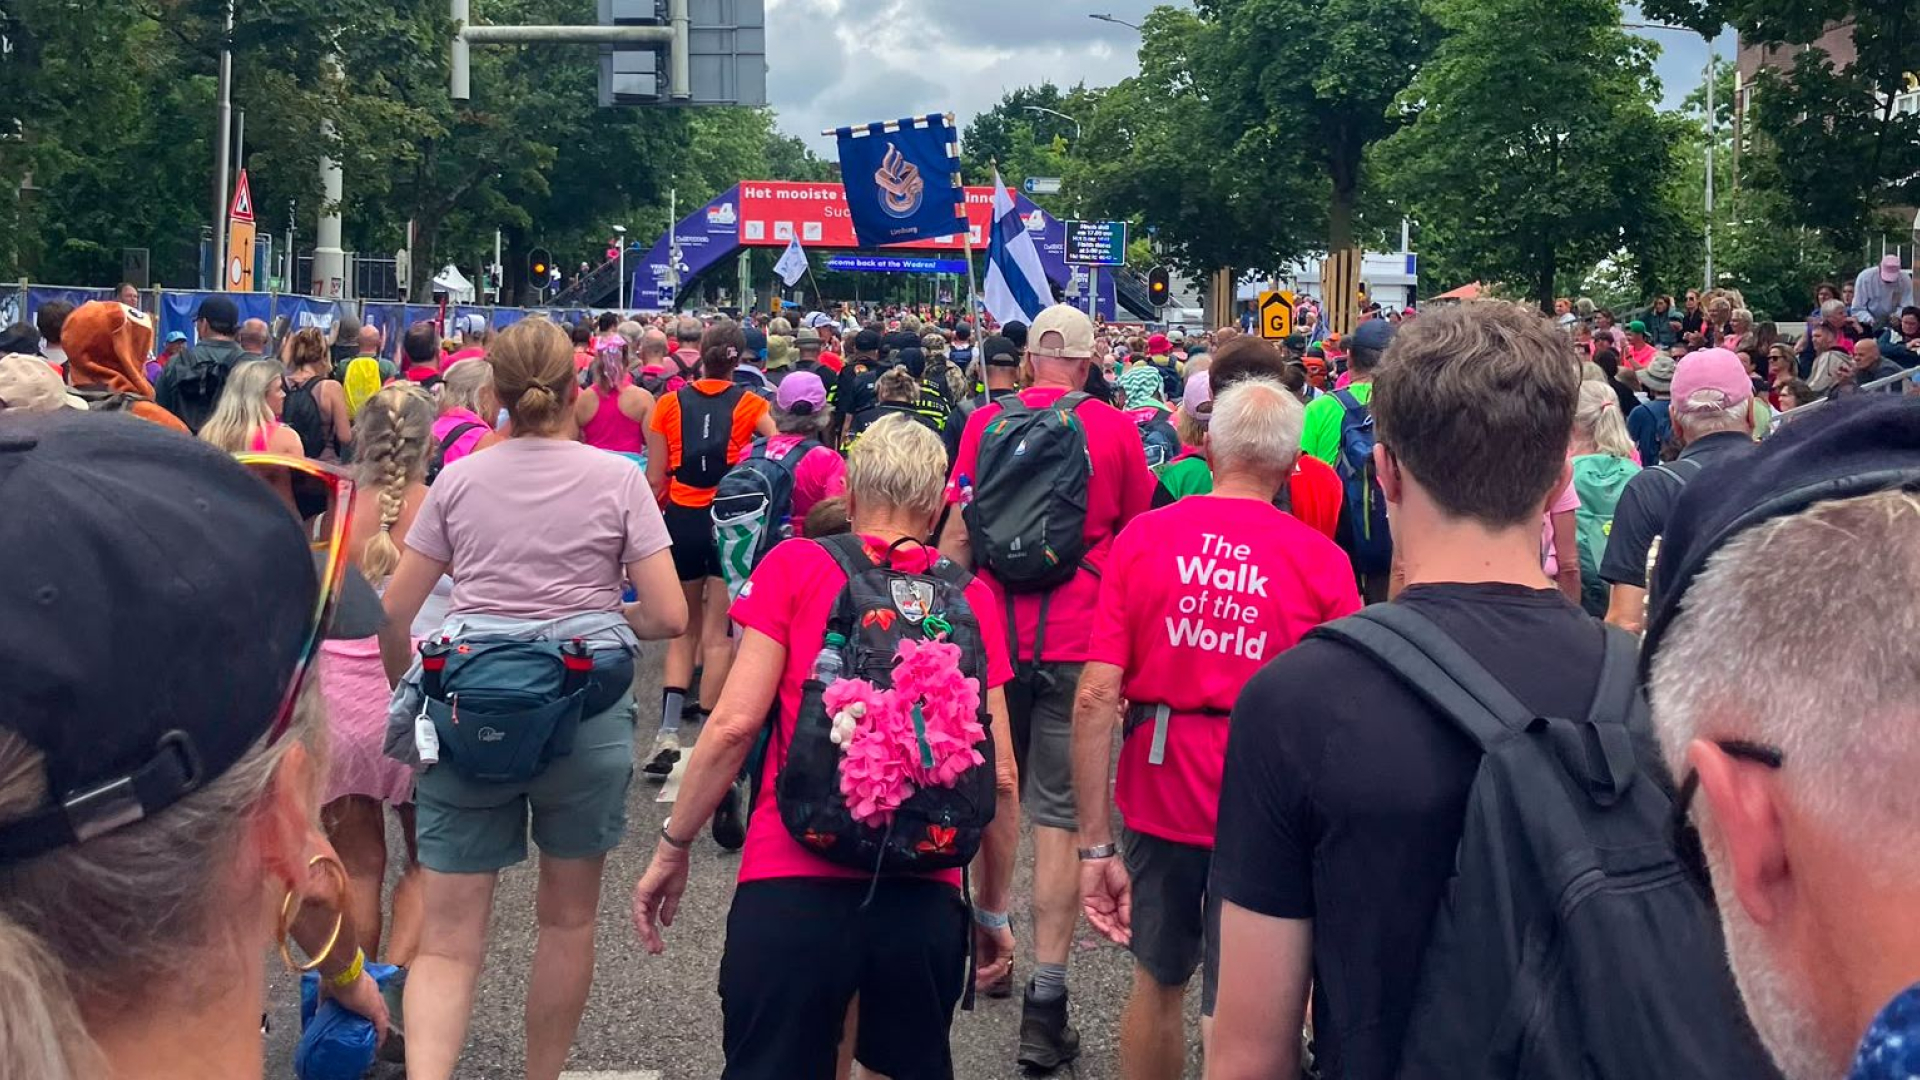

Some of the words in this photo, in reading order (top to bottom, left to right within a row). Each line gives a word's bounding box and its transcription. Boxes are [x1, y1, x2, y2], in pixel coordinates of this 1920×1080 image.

[745, 187, 772, 199] Het
[776, 187, 837, 200] mooiste
[856, 258, 876, 267] back
[888, 260, 900, 268] the
[902, 261, 936, 269] Wedren!
[1271, 315, 1284, 332] G
[1201, 532, 1251, 561] The
[1176, 555, 1270, 598] Walk
[1178, 589, 1209, 614] of
[1212, 594, 1259, 624] the
[1165, 616, 1268, 661] World
